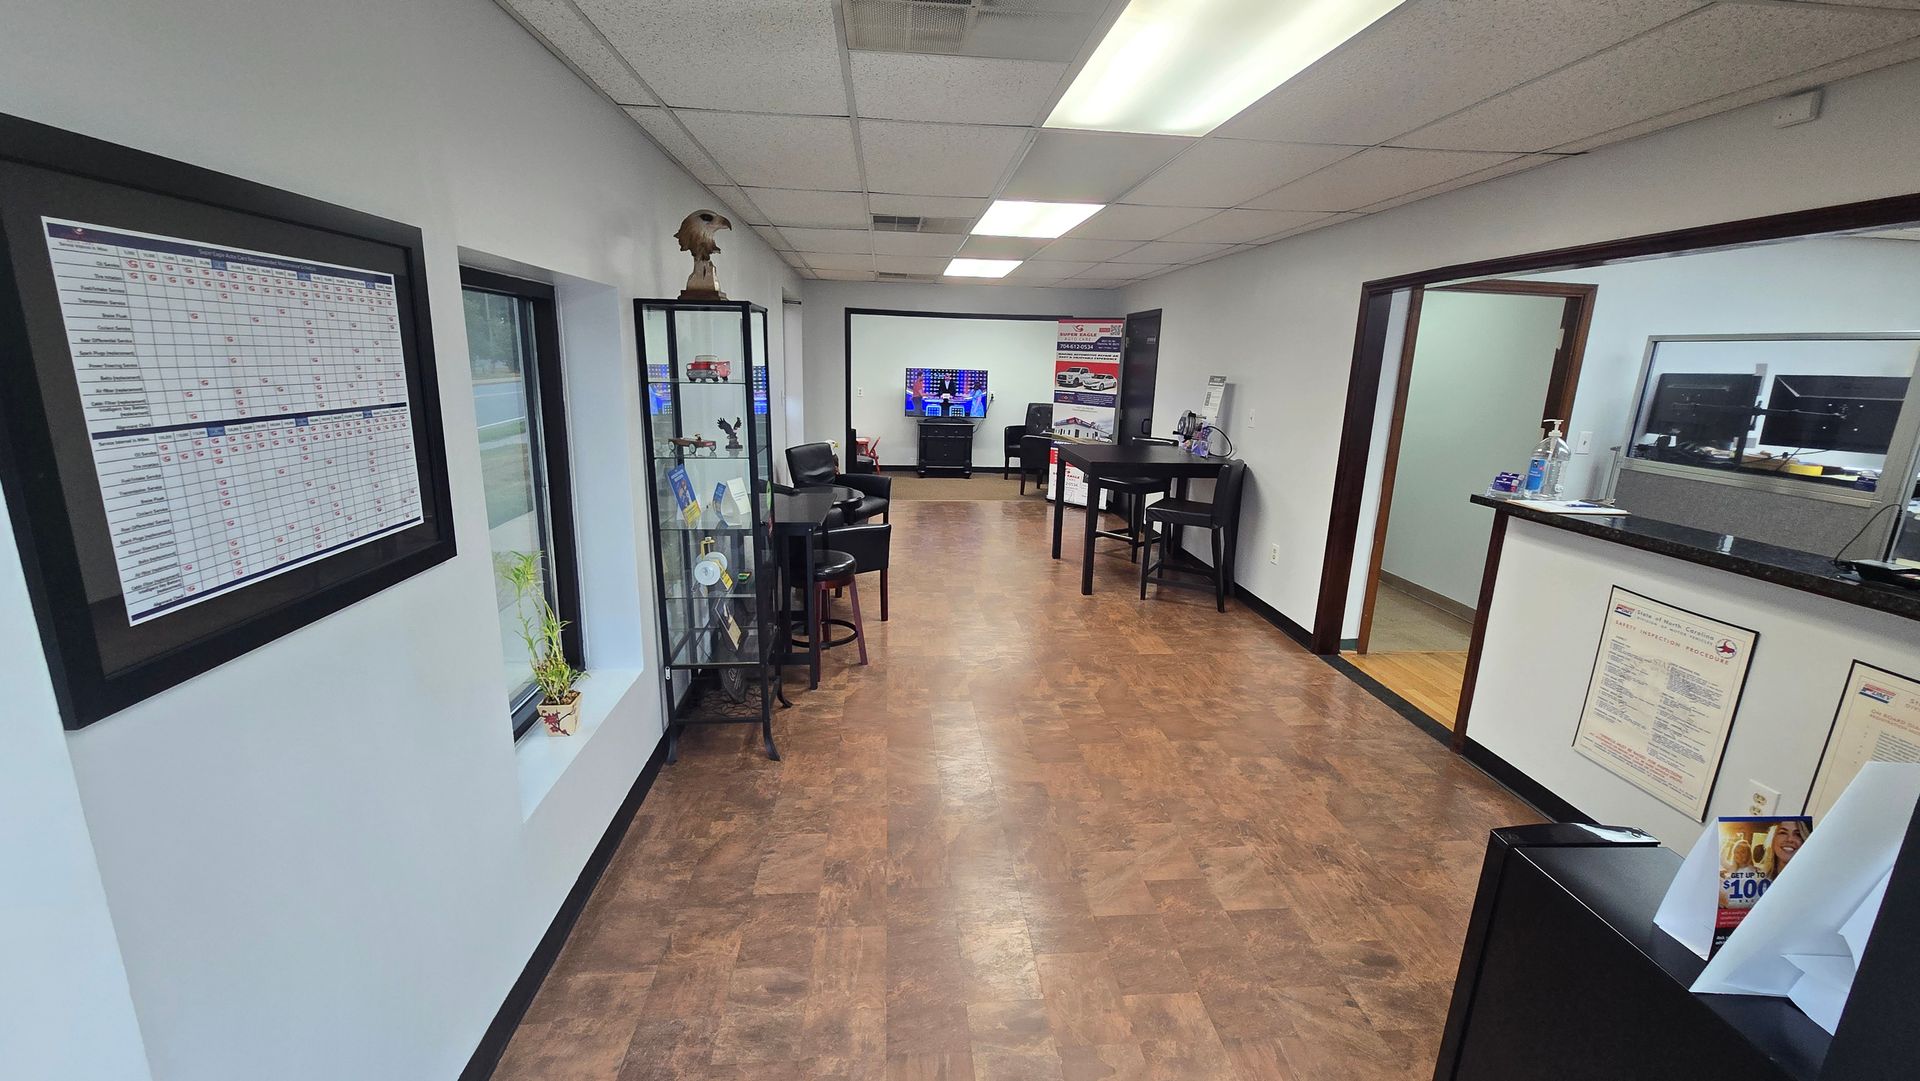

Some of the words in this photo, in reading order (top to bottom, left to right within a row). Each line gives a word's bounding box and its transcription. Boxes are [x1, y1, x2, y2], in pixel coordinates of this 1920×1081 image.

[1637, 610, 1652, 619] State
[1663, 619, 1682, 628] North
[1685, 626, 1715, 641] Carolina
[1615, 620, 1636, 631] SAFETY
[1640, 630, 1681, 648] INSPECTION
[1685, 646, 1729, 666] PROCEDURE
[1723, 878, 1771, 899] $100
